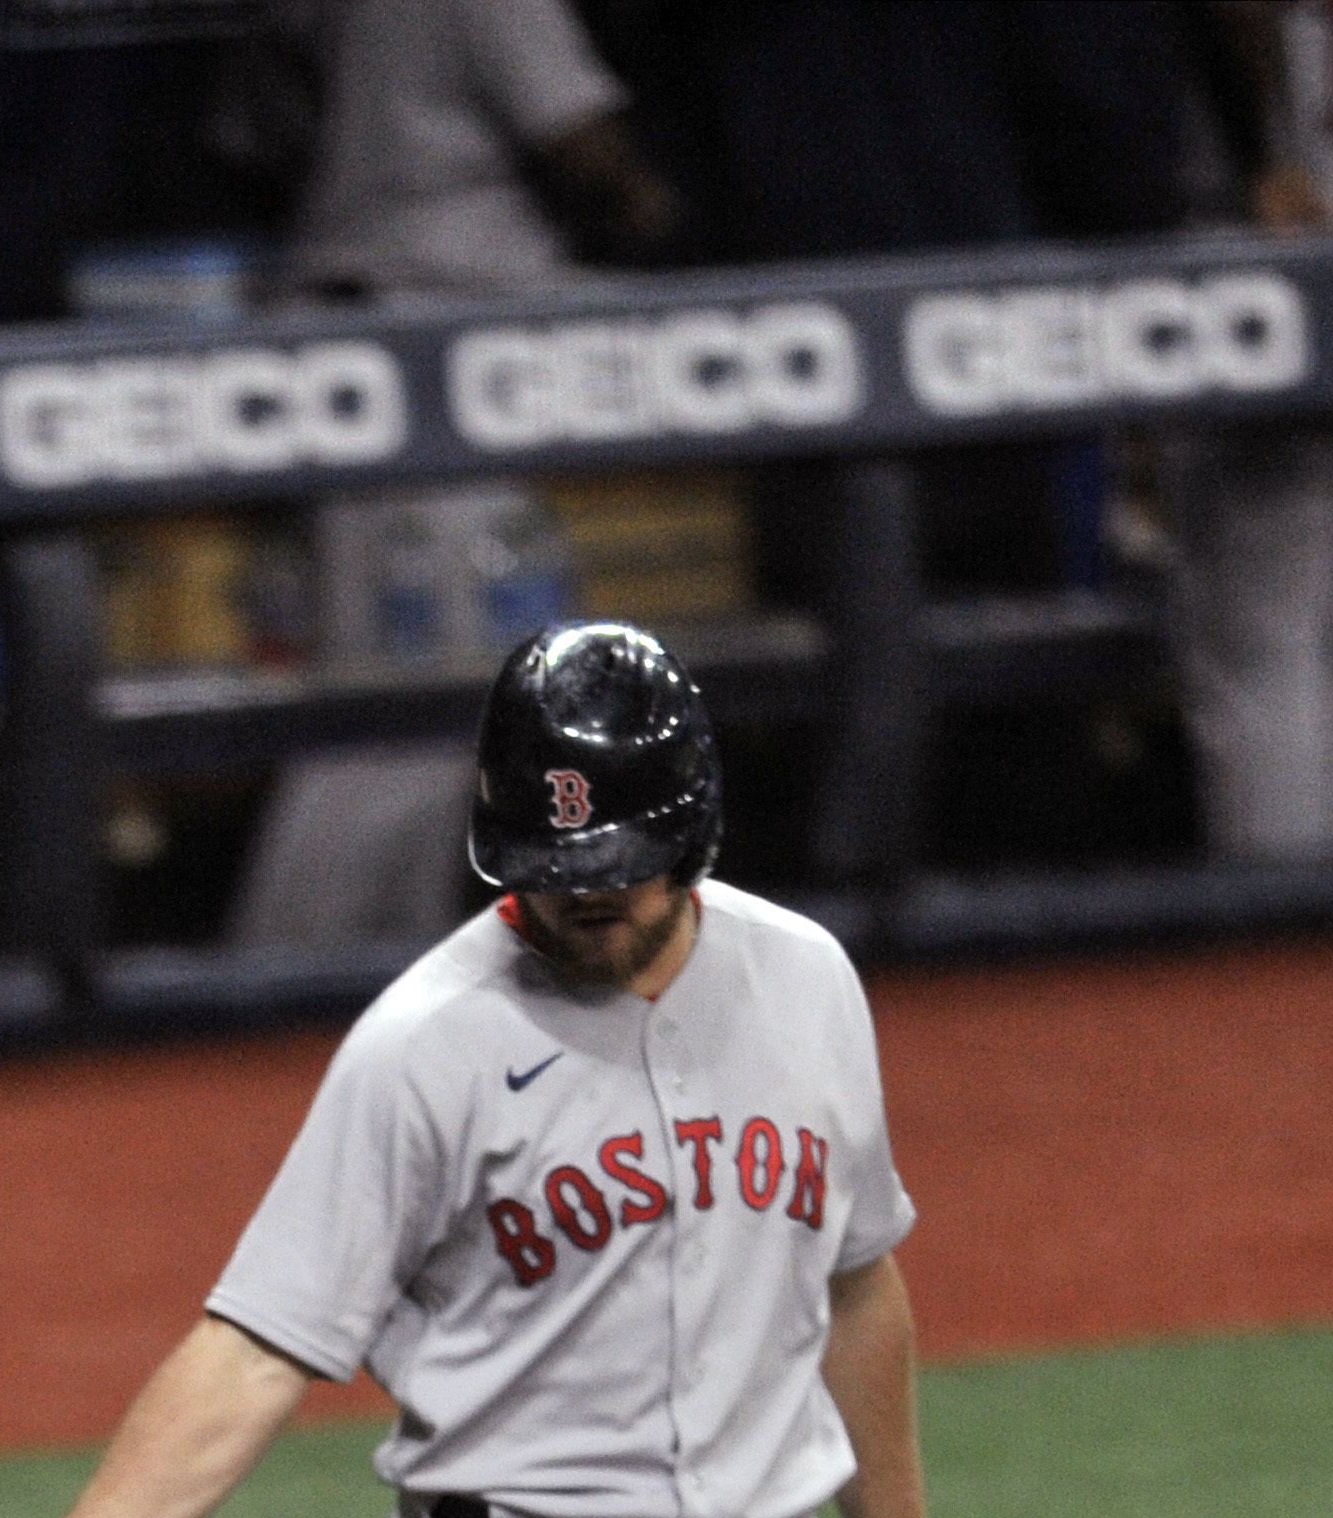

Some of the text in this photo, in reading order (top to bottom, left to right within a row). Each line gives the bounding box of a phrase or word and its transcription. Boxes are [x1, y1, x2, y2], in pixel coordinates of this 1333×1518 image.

[451, 303, 861, 447] GEICO
[905, 275, 1305, 413] GEICO
[544, 769, 592, 828] B
[486, 1115, 829, 1289] BOSTON
